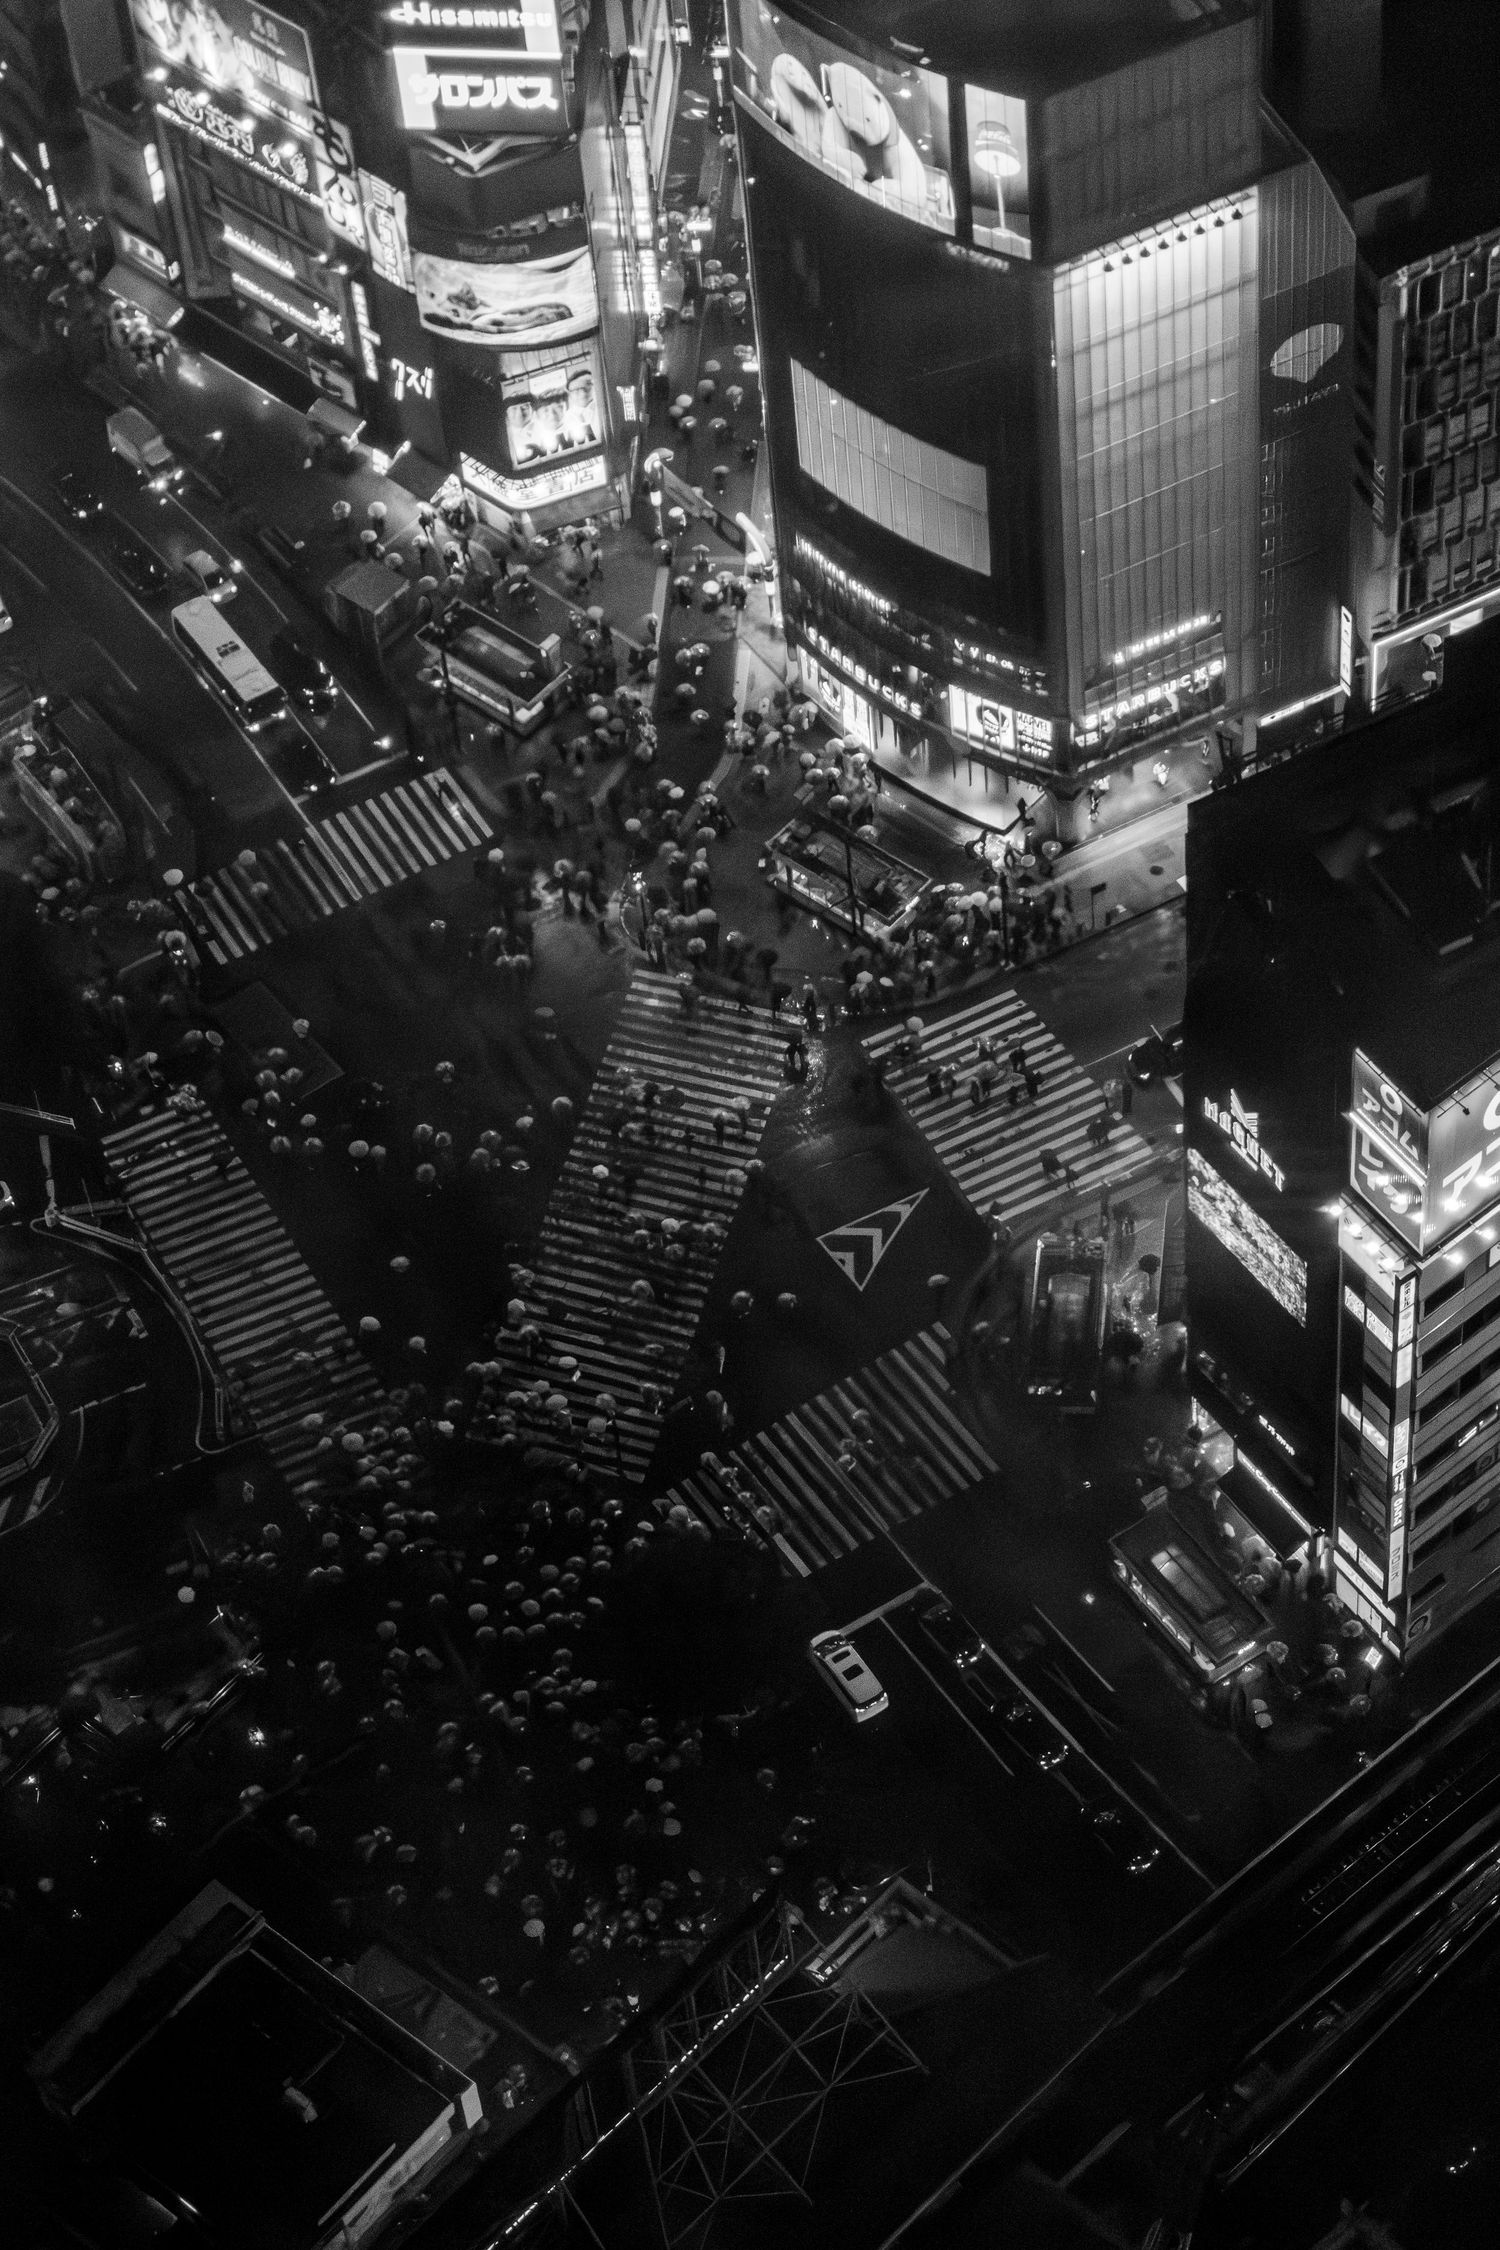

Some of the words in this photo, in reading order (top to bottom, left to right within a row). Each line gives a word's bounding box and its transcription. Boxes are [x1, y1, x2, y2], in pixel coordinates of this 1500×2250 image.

[390, 2, 552, 26] Hisamitsu
[408, 74, 559, 110] サロンパス
[391, 358, 433, 401] クスリ
[807, 626, 922, 717] STARBUCKS
[1085, 659, 1224, 730] STARBUCKS
[1204, 1096, 1285, 1192] MAGNET
